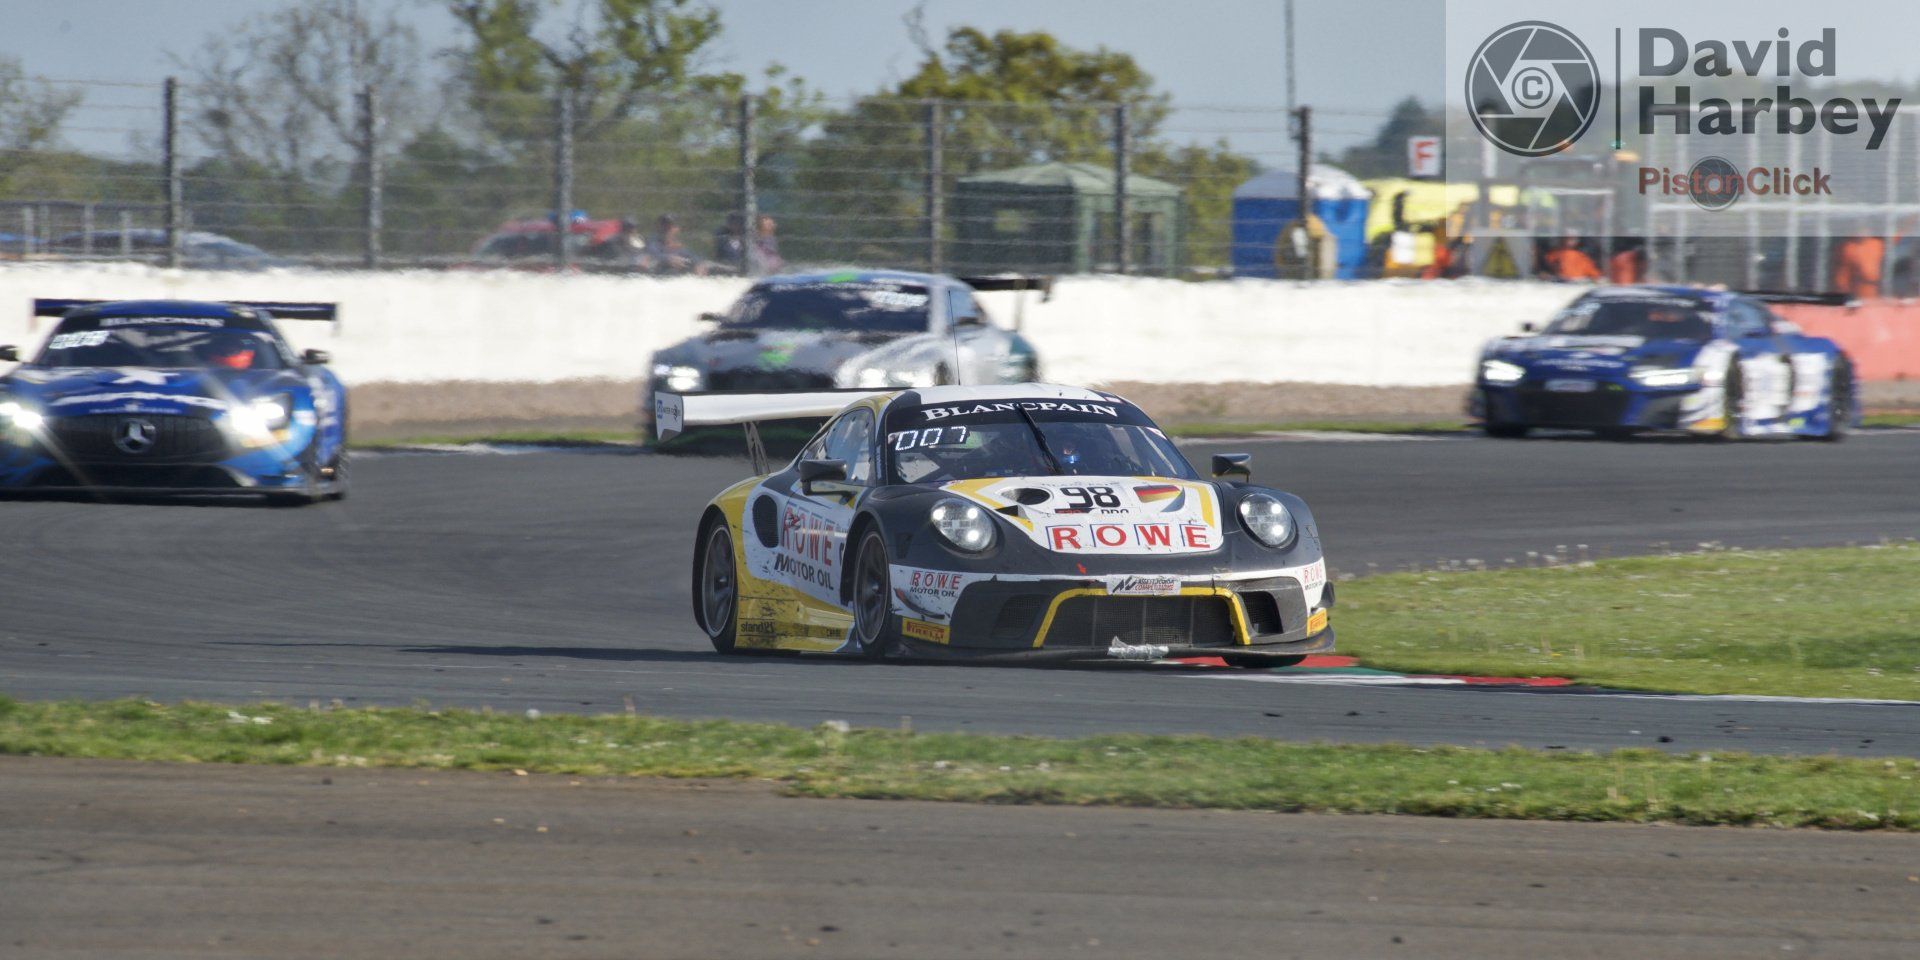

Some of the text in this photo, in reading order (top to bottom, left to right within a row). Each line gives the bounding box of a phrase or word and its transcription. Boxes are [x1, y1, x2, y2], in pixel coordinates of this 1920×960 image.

[1413, 140, 1437, 171] F
[921, 402, 1118, 422] BLANCPAIN
[1060, 486, 1121, 509] 98
[781, 506, 834, 567] ROWE
[1052, 525, 1211, 550] ROWE
[774, 553, 815, 583] MOTOR
[817, 569, 834, 591] OIL
[912, 572, 962, 590] ROWE
[910, 587, 957, 598] MOTOR OIL
